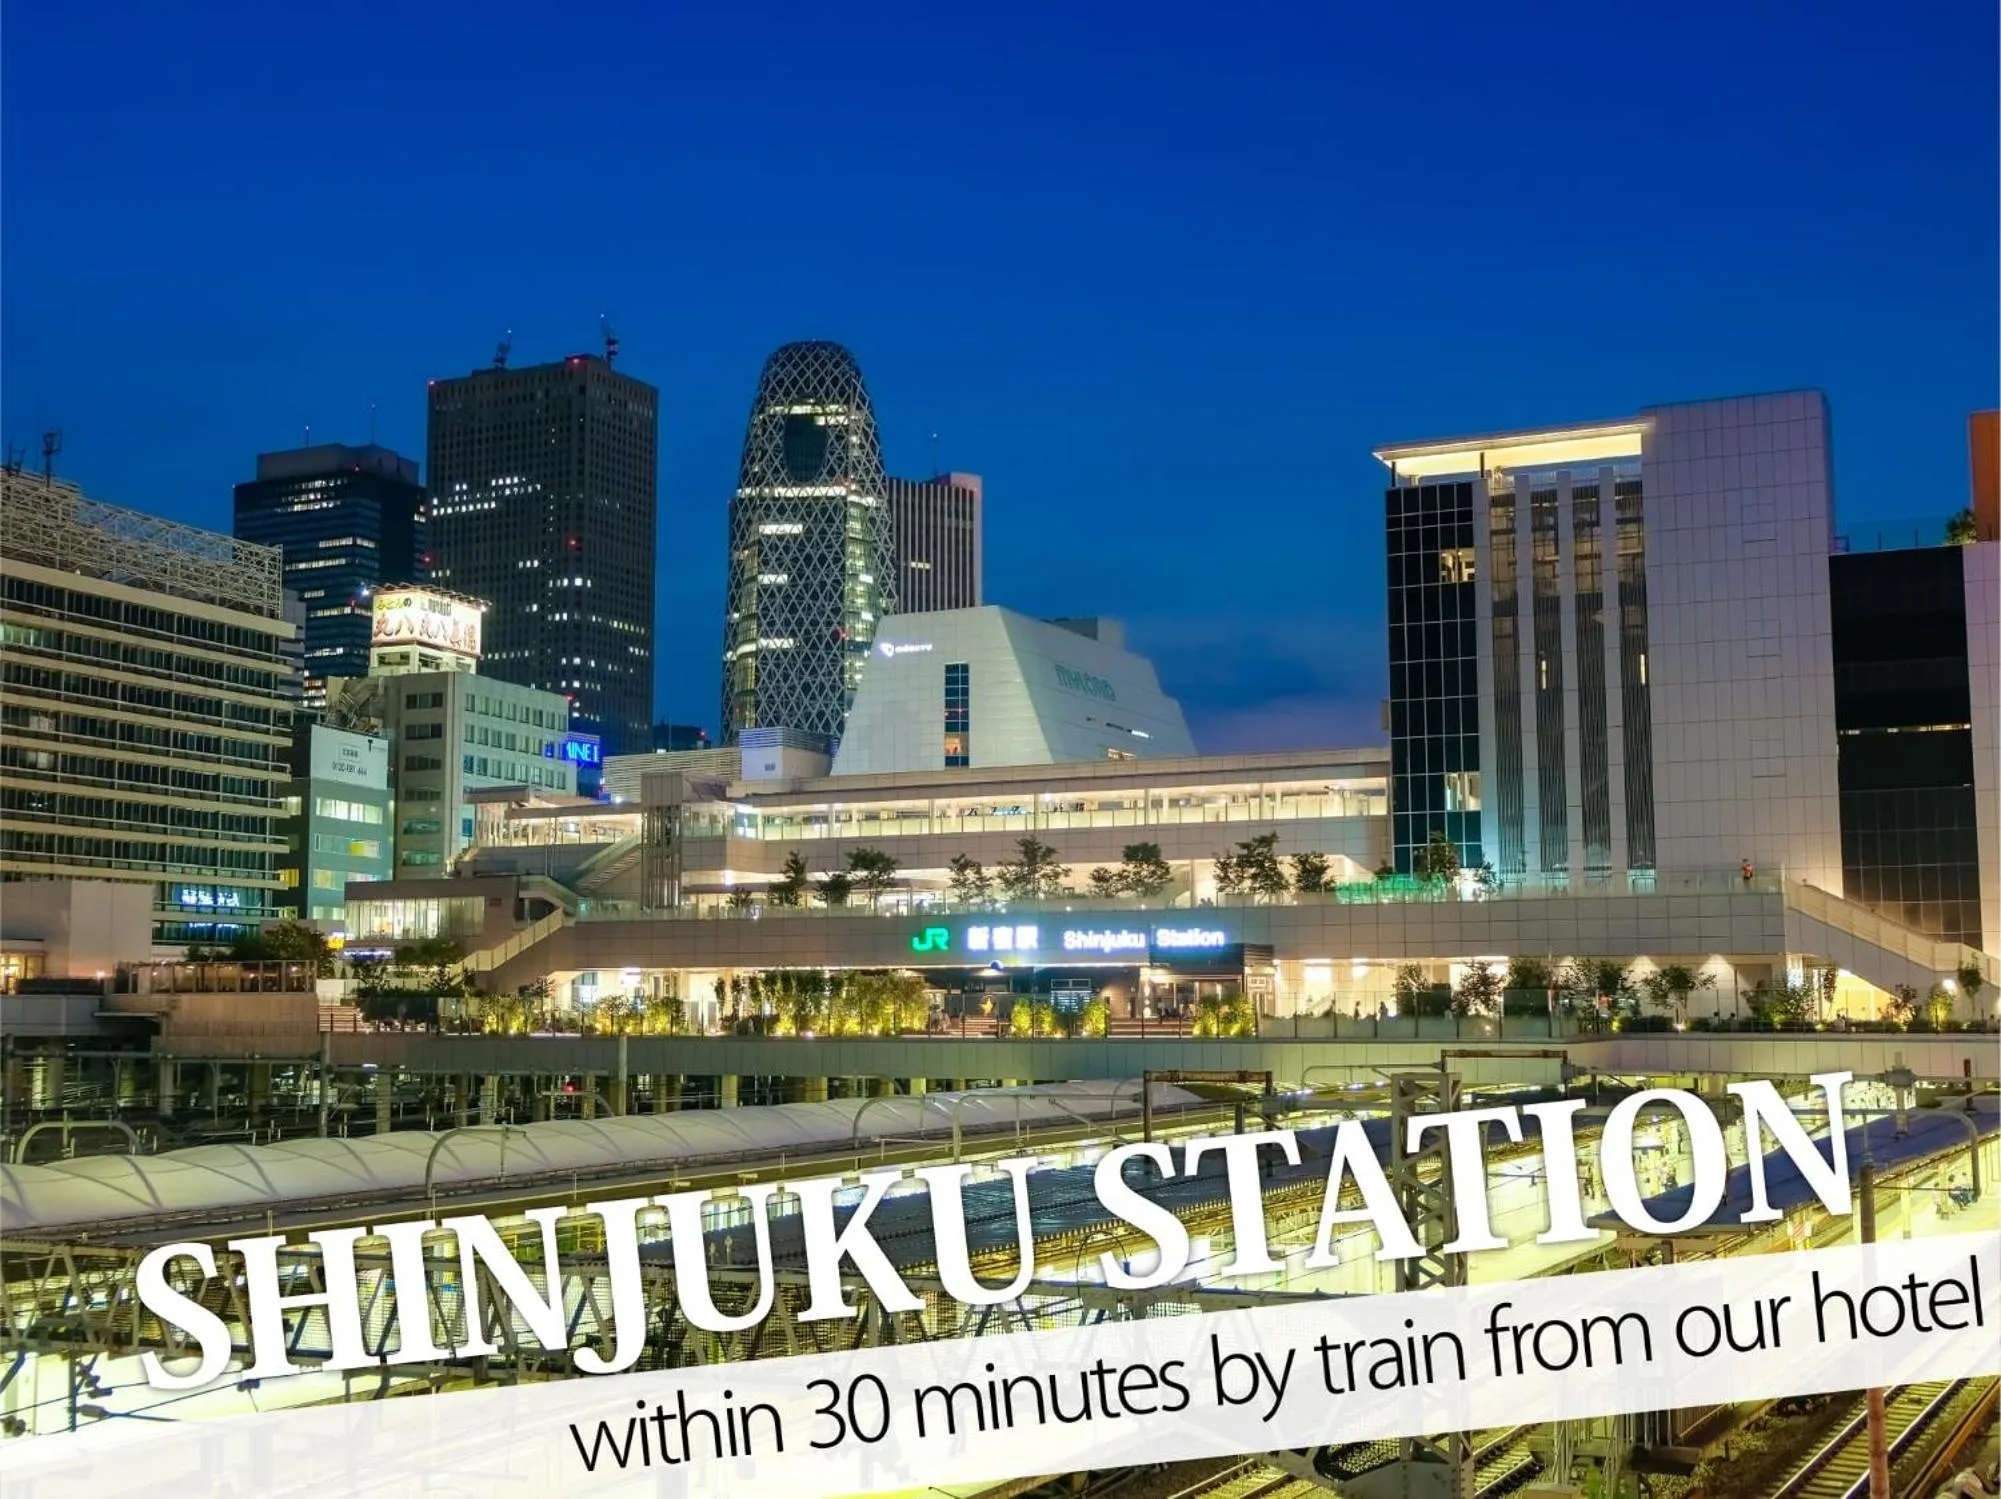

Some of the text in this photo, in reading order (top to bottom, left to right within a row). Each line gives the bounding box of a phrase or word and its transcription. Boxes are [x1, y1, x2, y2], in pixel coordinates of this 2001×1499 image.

[912, 927, 949, 951] JR
[967, 926, 1038, 950] 新宿駅
[1063, 928, 1225, 953] Shinjuku Station
